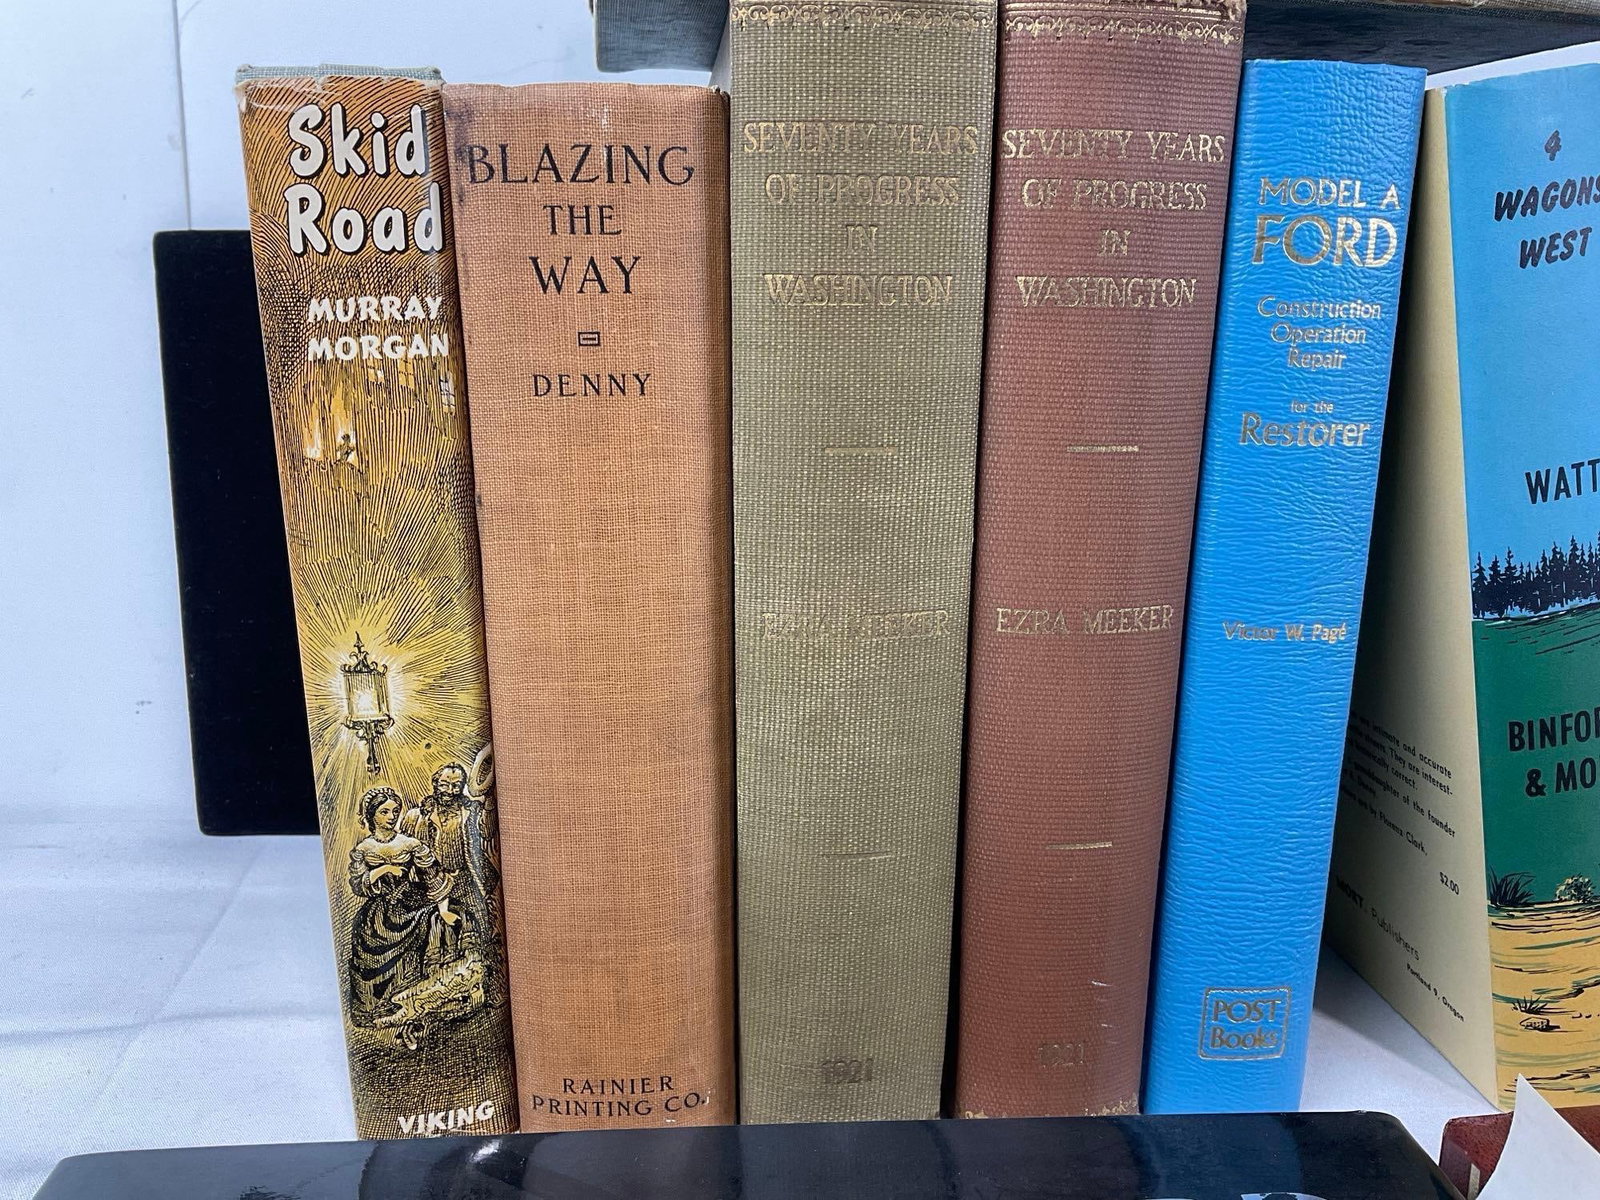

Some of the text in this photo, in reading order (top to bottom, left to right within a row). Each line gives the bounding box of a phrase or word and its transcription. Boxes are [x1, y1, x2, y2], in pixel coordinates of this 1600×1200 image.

[287, 102, 430, 180] Skid
[743, 122, 979, 157] SEVENTY YEARS
[1001, 128, 1226, 164] SEVENTY YEARS
[1544, 130, 1562, 161] 4
[468, 144, 695, 185] BLAZING
[765, 173, 960, 206] OF PROGRESS
[1022, 178, 1208, 211] OF PROGRESS
[1258, 176, 1401, 210] MODEL A
[283, 181, 443, 255] Road
[543, 204, 622, 236] THE
[847, 225, 879, 256] IN
[1100, 229, 1132, 256] IN
[1251, 214, 1398, 268] FORD
[1520, 227, 1593, 269] WEST
[529, 256, 641, 295] WAY
[764, 273, 954, 308] WASHINGTON
[1016, 276, 1197, 308] WASHINGTON
[1257, 295, 1382, 320] Construction
[307, 295, 442, 323] MURRAY
[307, 333, 449, 361] MORGAN
[1270, 322, 1367, 346] Operation
[1287, 349, 1347, 371] Repair
[533, 373, 651, 398] DENNY
[1290, 400, 1334, 414] for the
[1240, 412, 1371, 448] Restorer
[1525, 458, 1600, 505] WATT
[762, 610, 952, 641] EZRA MEEKER
[995, 604, 1175, 635] EZRA MEEKER
[1222, 620, 1348, 644] Victor W. Pagé
[1403, 742, 1416, 757] and
[1419, 752, 1452, 780] accurate
[1408, 762, 1420, 776] are
[1422, 767, 1453, 796] interest-
[1525, 768, 1547, 797] &
[1413, 800, 1425, 817] the
[1428, 809, 1456, 838] founder
[1439, 871, 1460, 896] $2.00
[1371, 906, 1420, 961] Publishers
[1212, 999, 1282, 1023] POST
[1210, 1026, 1279, 1050] Books
[563, 1075, 674, 1096] RAINIER
[397, 1100, 495, 1135] VIKING
[532, 1091, 706, 1117] PRINTING CO.
